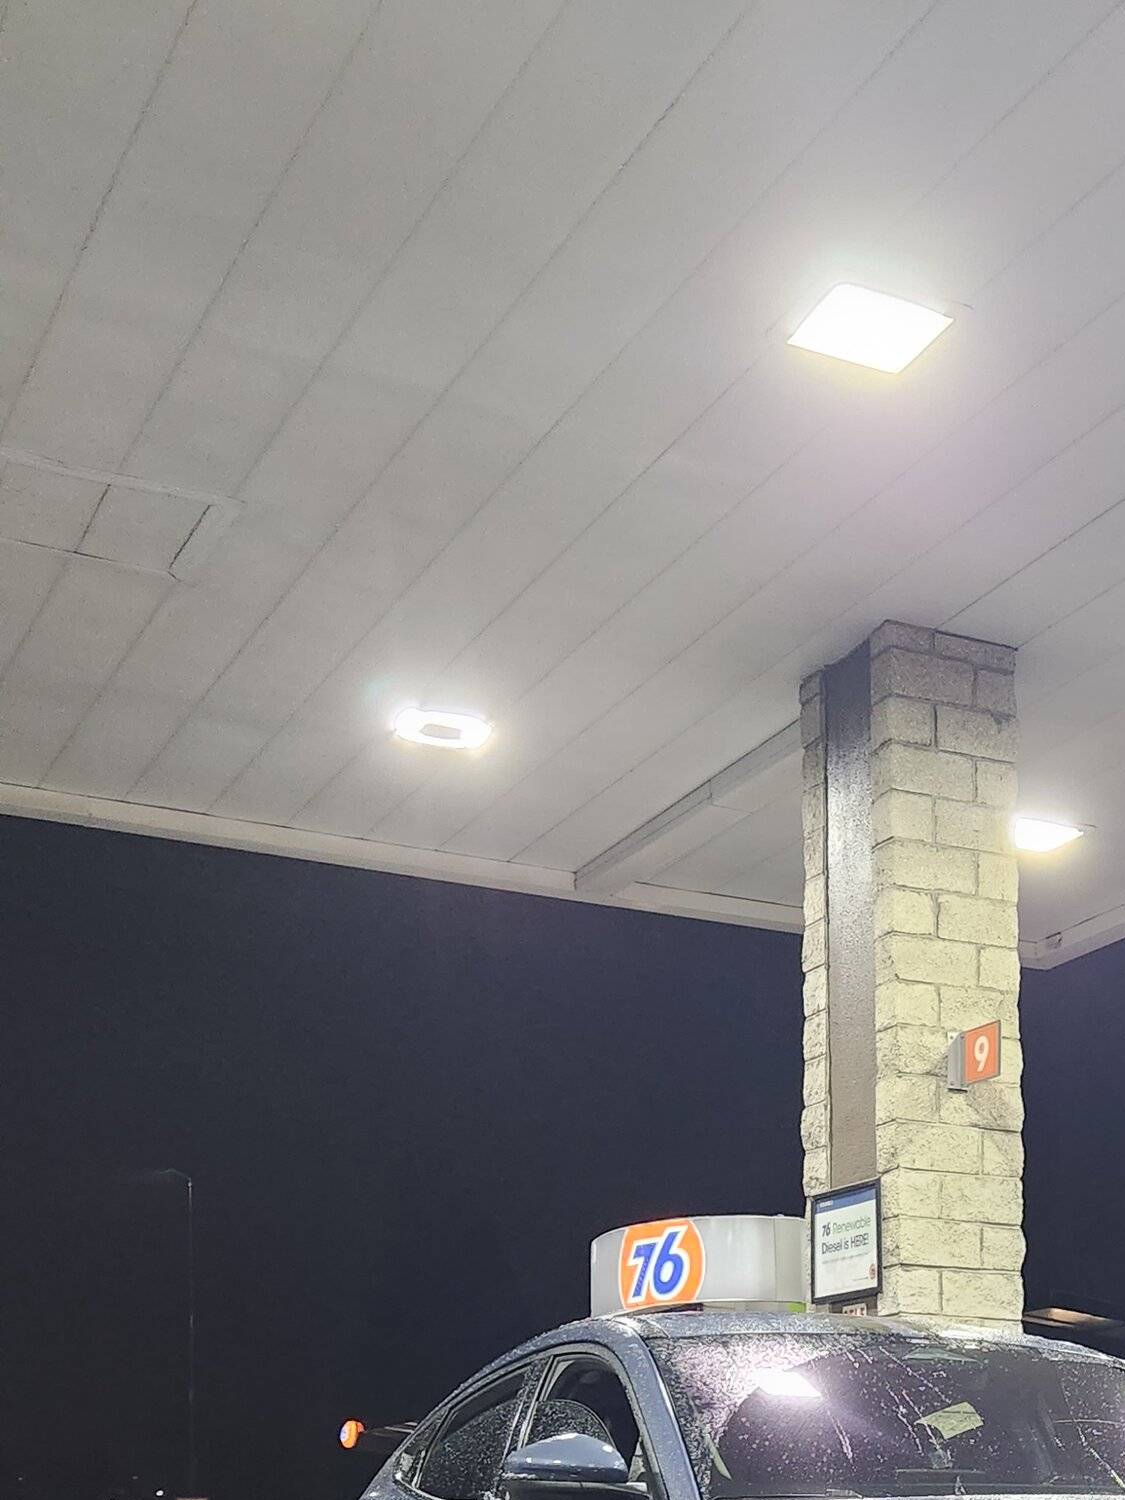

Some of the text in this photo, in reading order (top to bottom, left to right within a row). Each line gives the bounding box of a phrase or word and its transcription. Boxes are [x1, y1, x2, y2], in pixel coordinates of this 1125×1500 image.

[974, 1035, 990, 1073] 9
[629, 1228, 687, 1300] 76
[822, 1240, 842, 1254] Diesel
[843, 1236, 849, 1250] is
